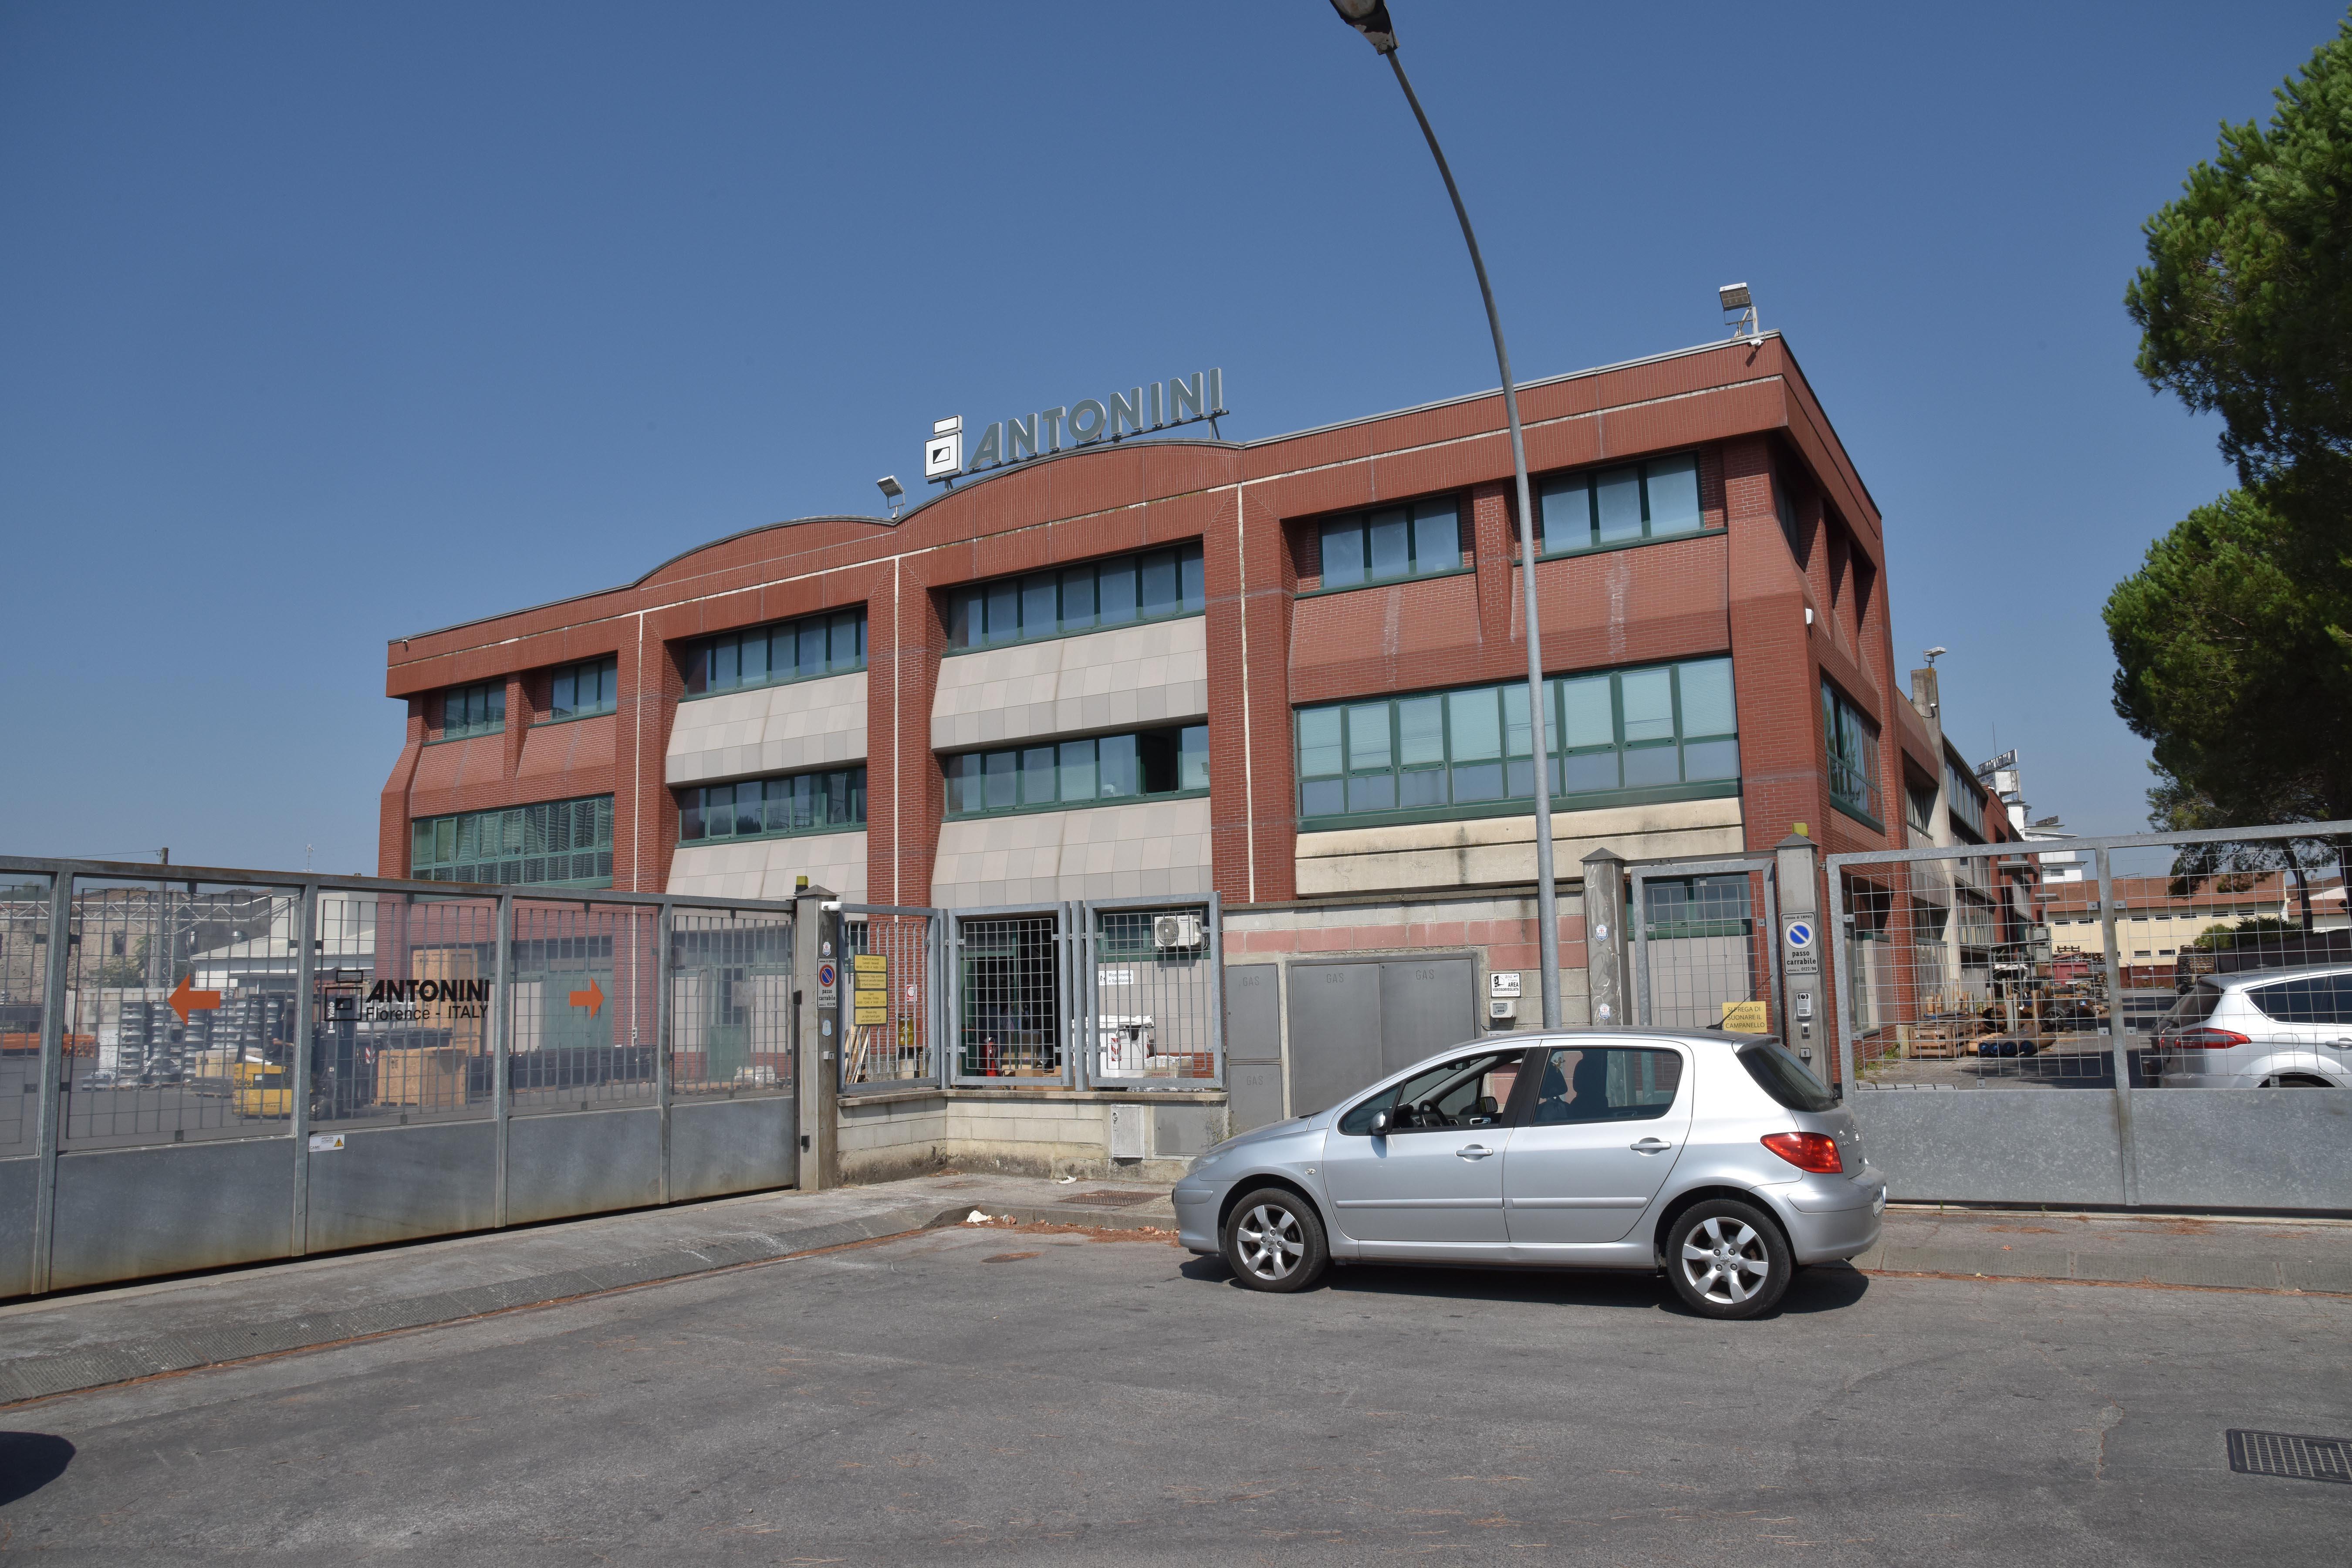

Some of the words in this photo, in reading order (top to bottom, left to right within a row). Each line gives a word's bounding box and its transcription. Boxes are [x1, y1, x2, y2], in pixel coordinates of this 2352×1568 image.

[968, 368, 1223, 469] ANTONINI
[1326, 973, 1345, 983] GAS
[1416, 969, 1434, 980] GAS
[1243, 977, 1260, 986] GAS
[365, 980, 490, 1003] ANTONINI
[366, 1007, 430, 1021] Florence
[449, 1005, 488, 1019] ITALY
[1247, 1075, 1264, 1085] GAS
